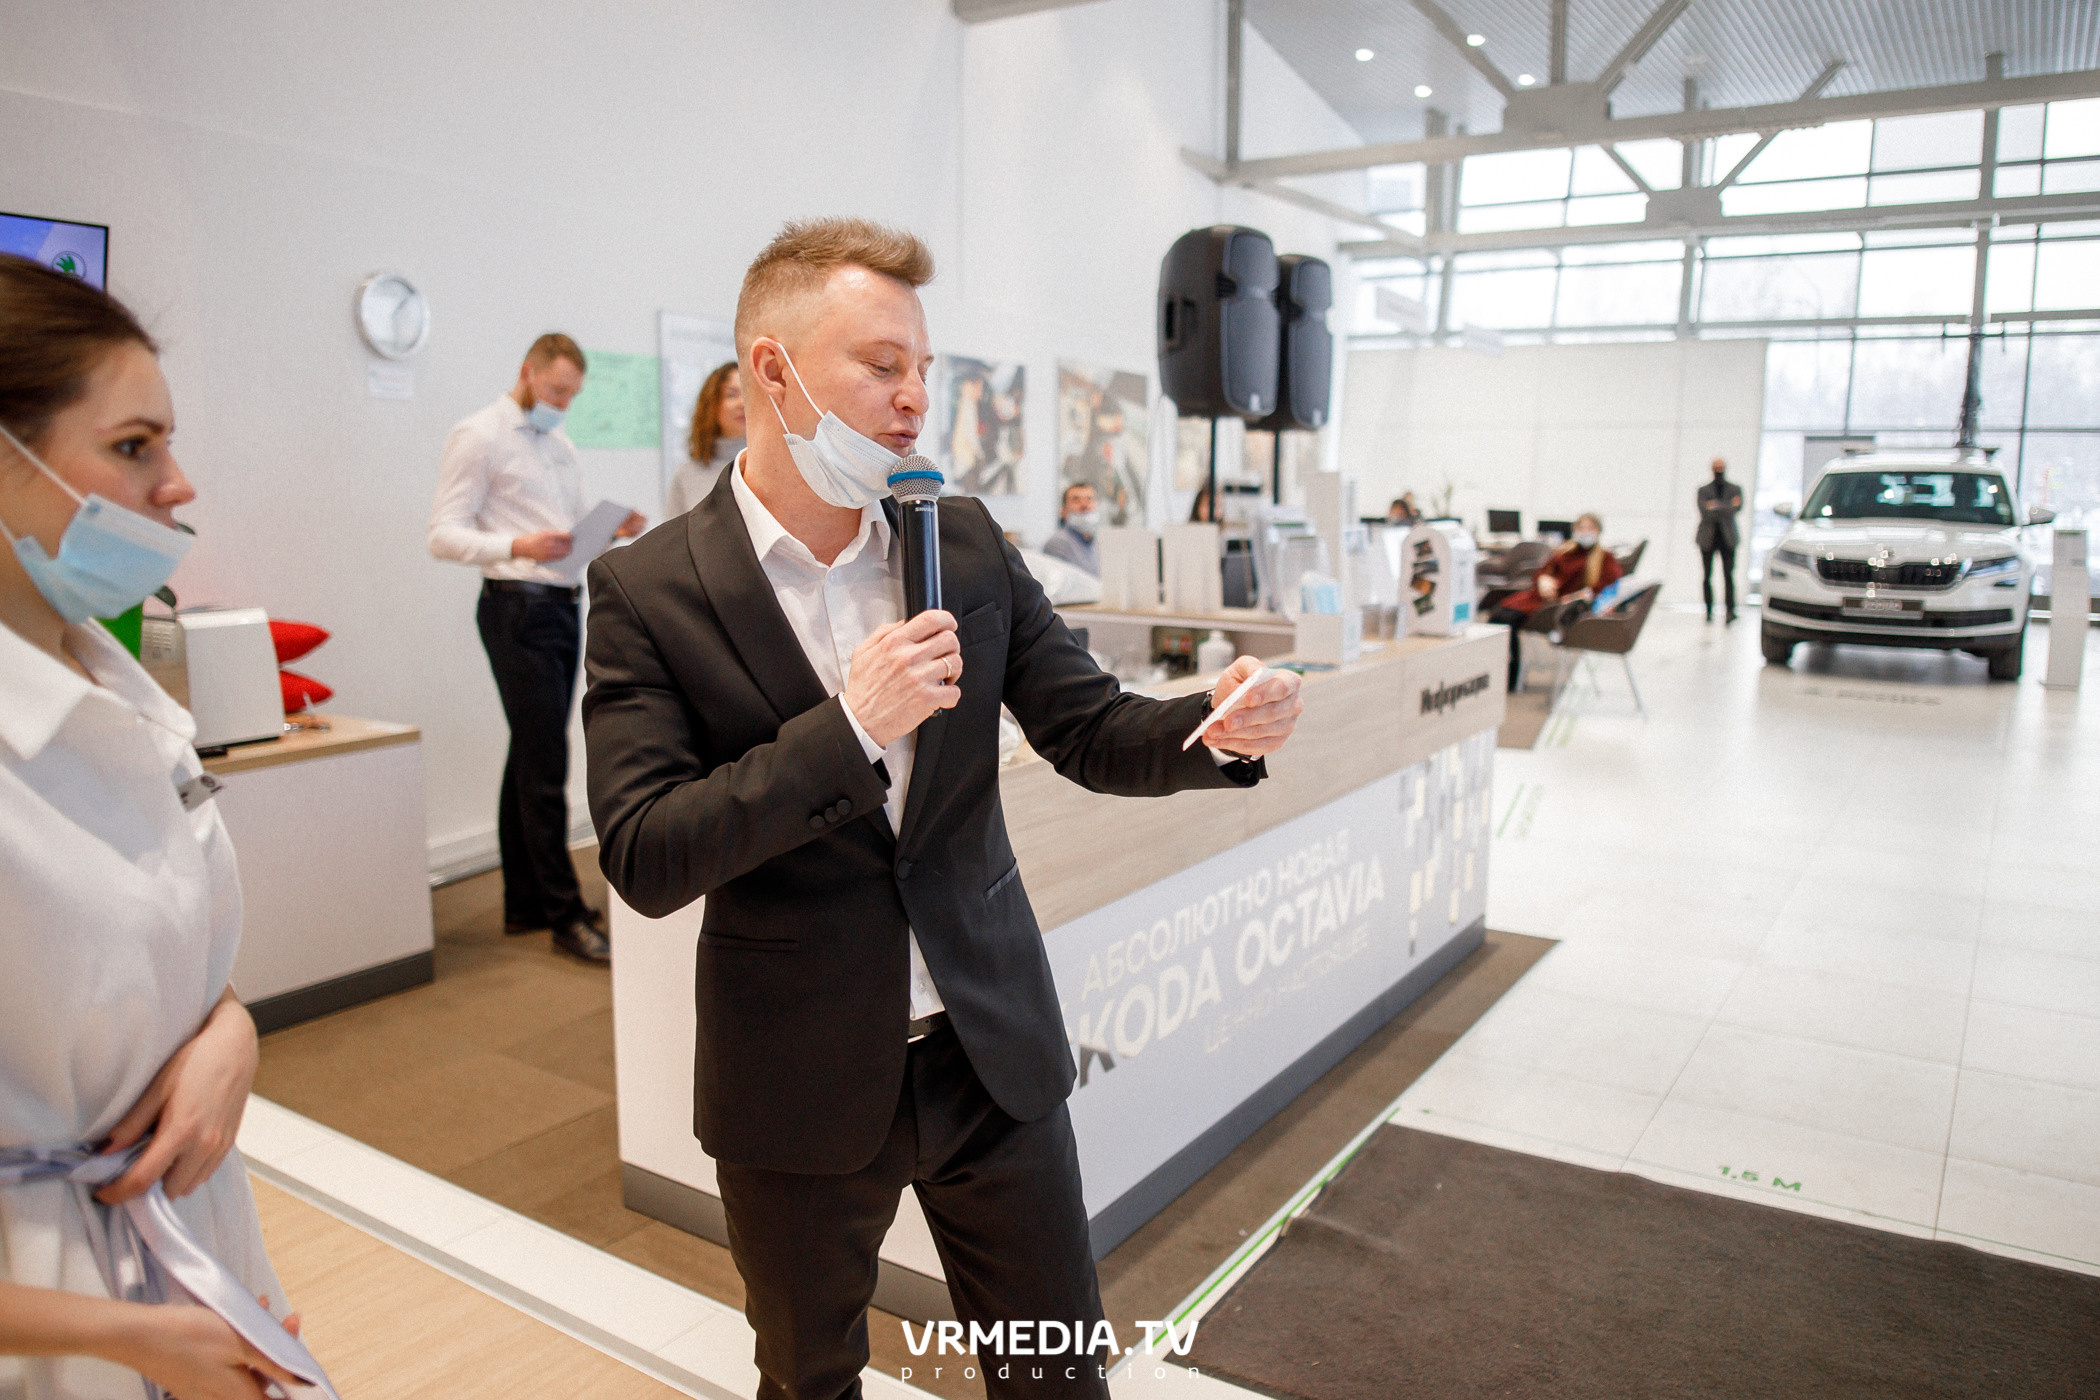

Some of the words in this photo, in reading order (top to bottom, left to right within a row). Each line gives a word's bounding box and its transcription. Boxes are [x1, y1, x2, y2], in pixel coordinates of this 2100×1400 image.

[1061, 945, 1222, 1089] KODA
[1235, 854, 1385, 986] OCTAVIA
[1081, 868, 1272, 1002] АБСОЛЮТНО
